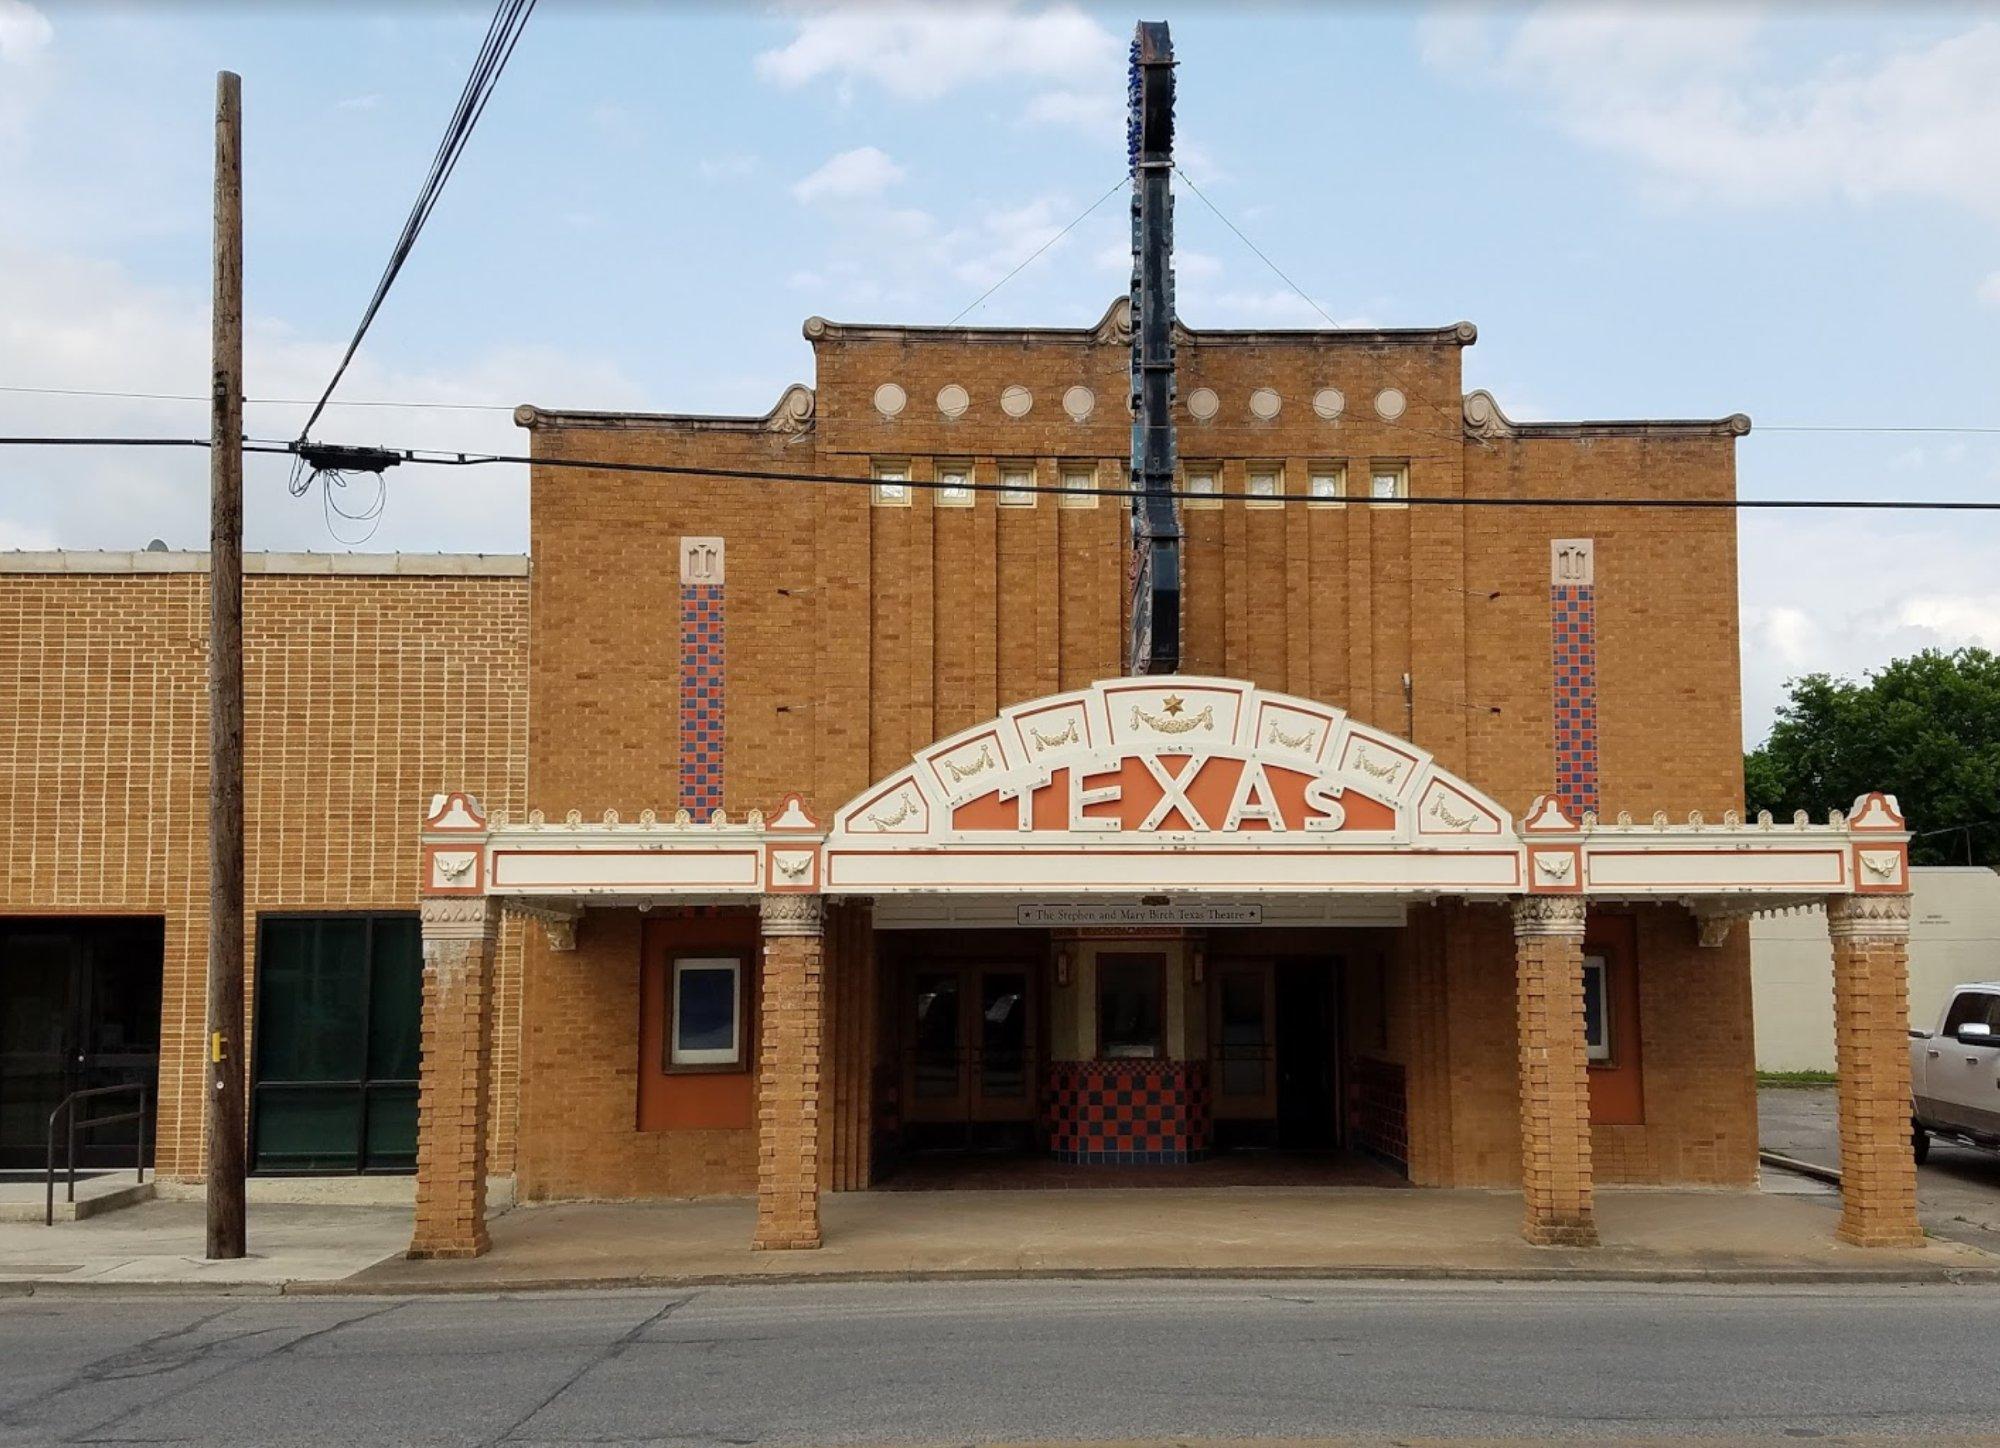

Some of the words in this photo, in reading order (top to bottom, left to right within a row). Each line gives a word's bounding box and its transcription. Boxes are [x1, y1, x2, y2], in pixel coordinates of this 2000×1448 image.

[999, 754, 1346, 832] TEXAS
[1036, 909, 1054, 920] The
[1058, 909, 1095, 922] Stephen
[1099, 909, 1117, 920] and
[1120, 909, 1146, 921] Mary
[1149, 909, 1175, 920] Birch
[1179, 909, 1204, 920] Texas
[1207, 909, 1245, 920] Theatre
